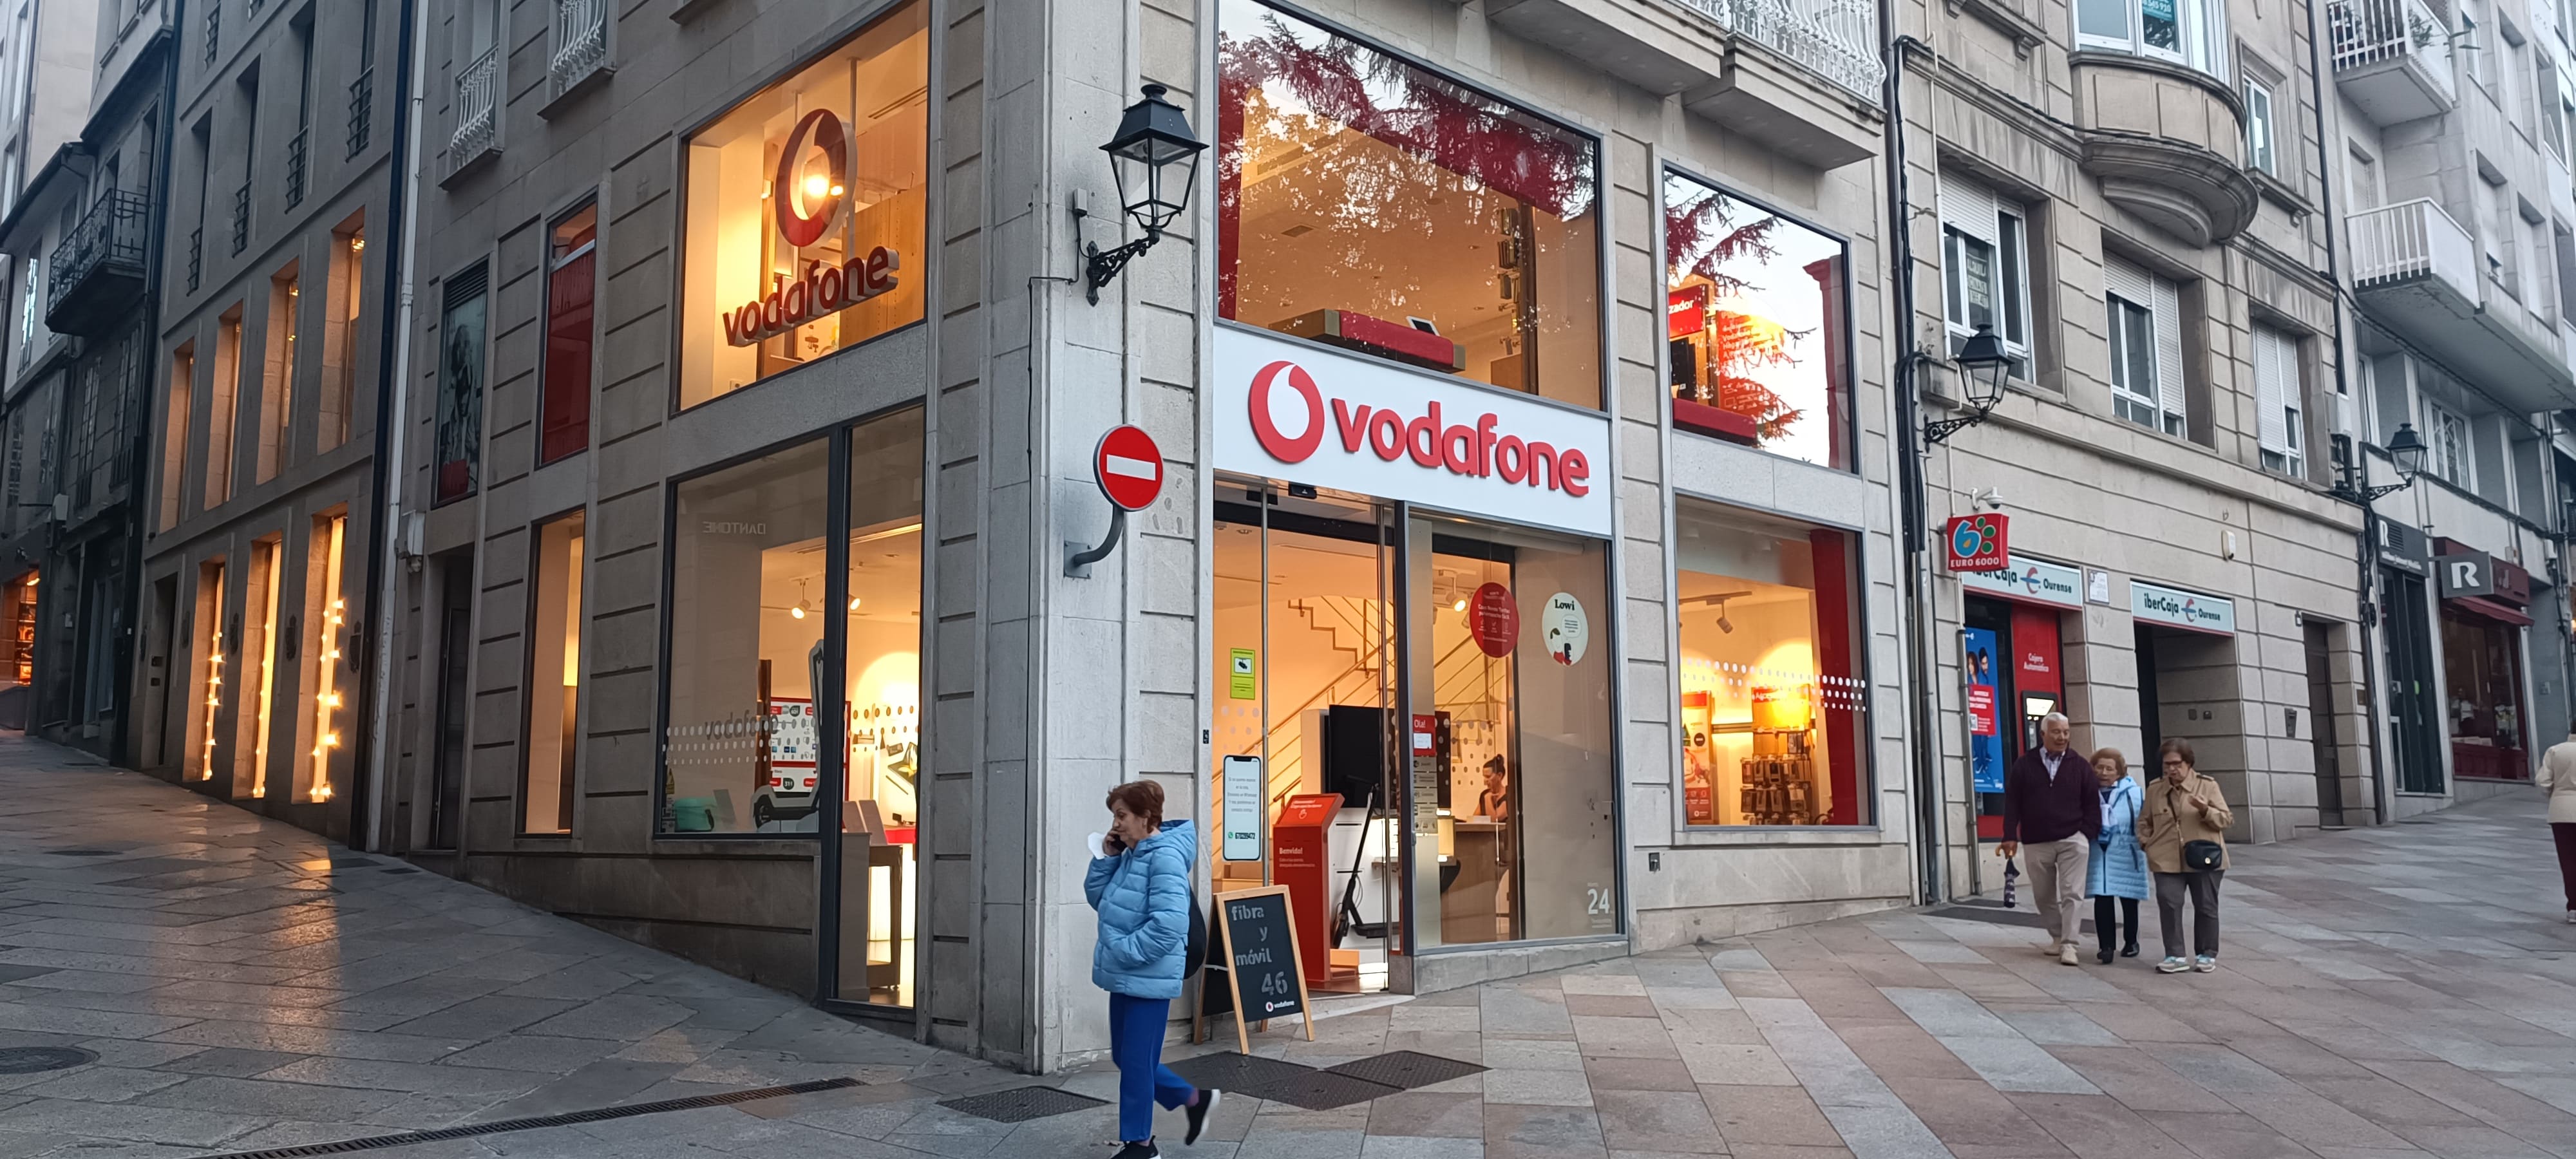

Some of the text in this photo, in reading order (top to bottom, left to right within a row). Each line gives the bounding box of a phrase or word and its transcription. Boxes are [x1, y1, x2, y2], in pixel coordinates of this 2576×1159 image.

[723, 246, 900, 347] vodafone
[1331, 398, 1589, 497] vodafone
[2379, 520, 2390, 547] R
[1951, 557, 2000, 567] EURO 6000
[1973, 569, 2018, 587] erCaja
[2043, 579, 2072, 594] Ourense
[2451, 561, 2480, 589] R
[1555, 599, 1575, 610] Lowi
[2144, 592, 2221, 621] iberCaja Ourense
[704, 709, 780, 740] vodafone
[1231, 905, 1264, 921] fibra
[1587, 889, 1610, 914] 24
[1260, 927, 1268, 941] y
[1236, 947, 1272, 966] móvil
[1261, 971, 1288, 995] 46
